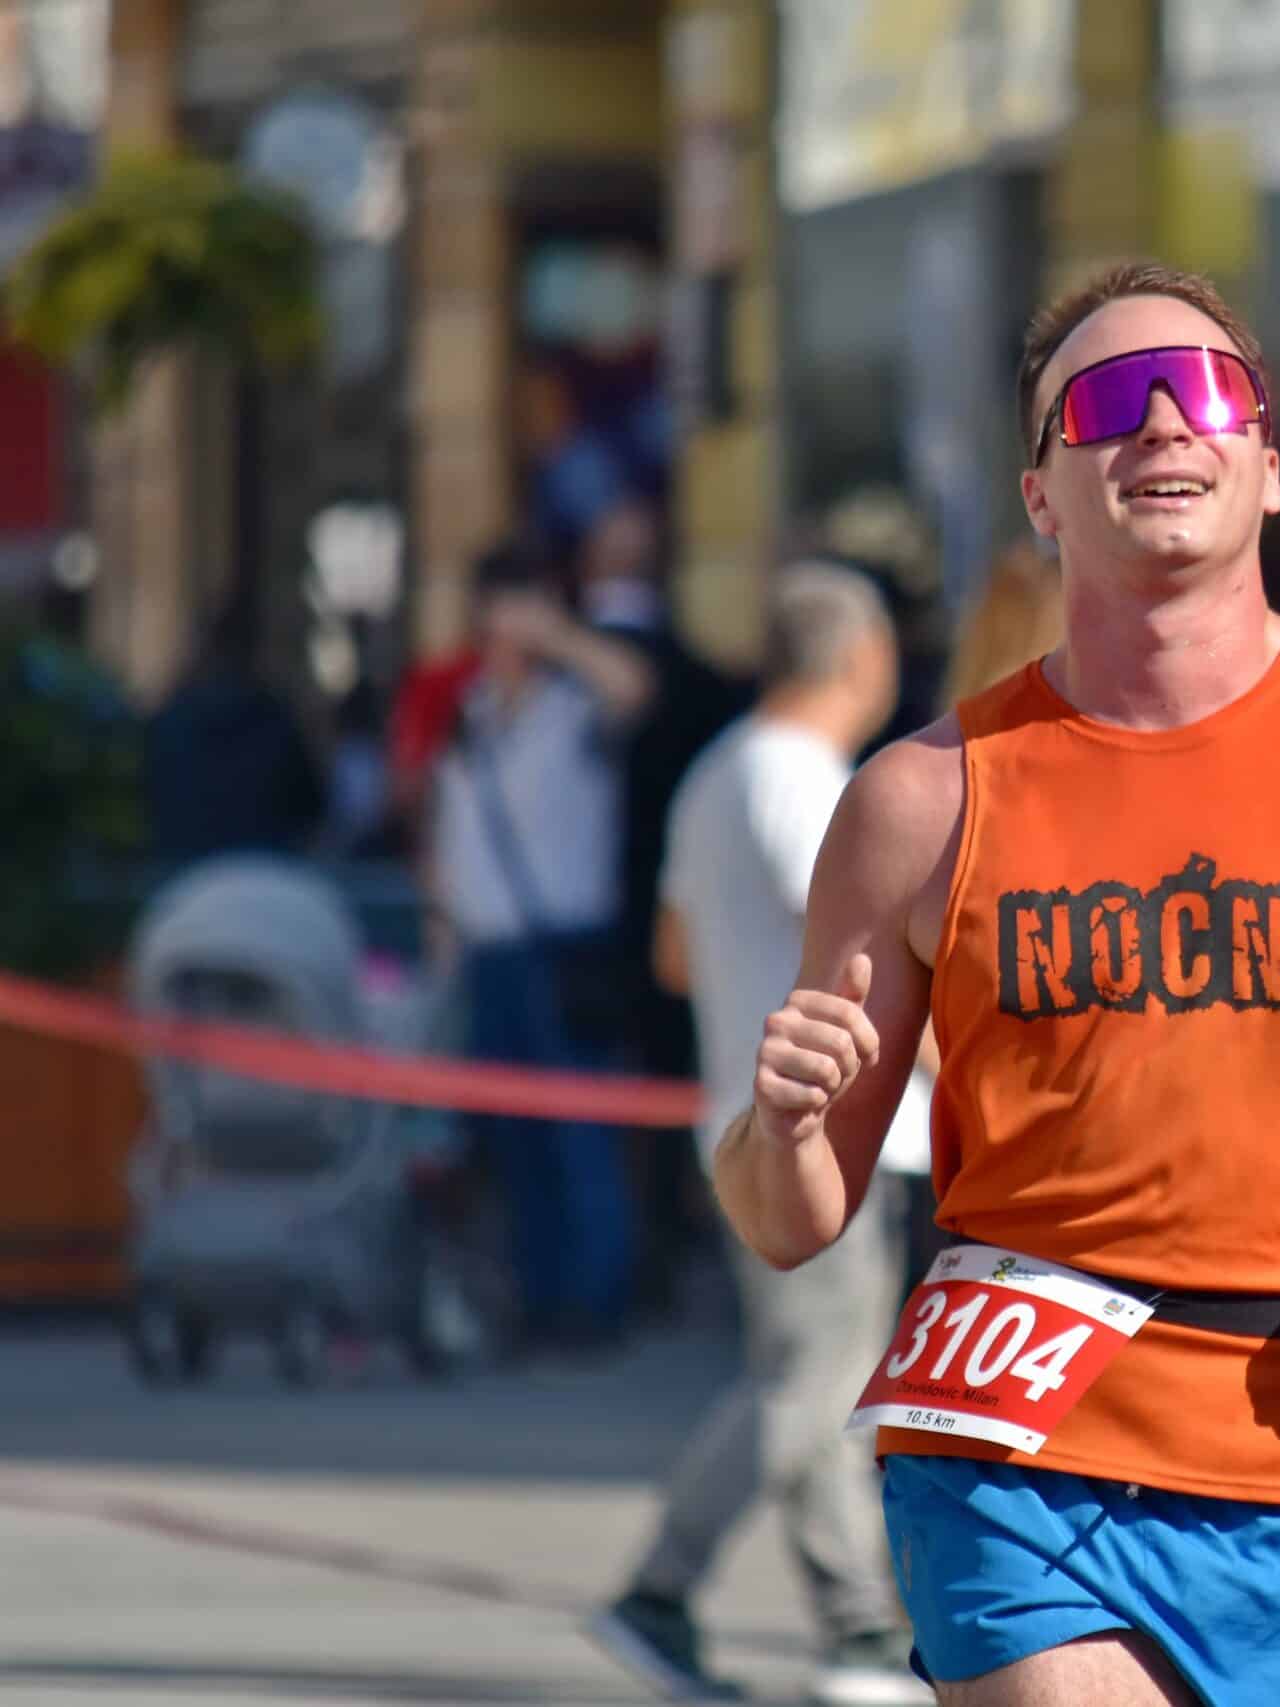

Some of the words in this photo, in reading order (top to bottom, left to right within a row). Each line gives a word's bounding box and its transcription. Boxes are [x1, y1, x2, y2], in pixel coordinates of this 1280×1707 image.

[887, 1291, 1093, 1402] 3104
[963, 1388, 999, 1406] Milan
[905, 1410, 933, 1425] 10.5
[934, 1414, 956, 1429] km
